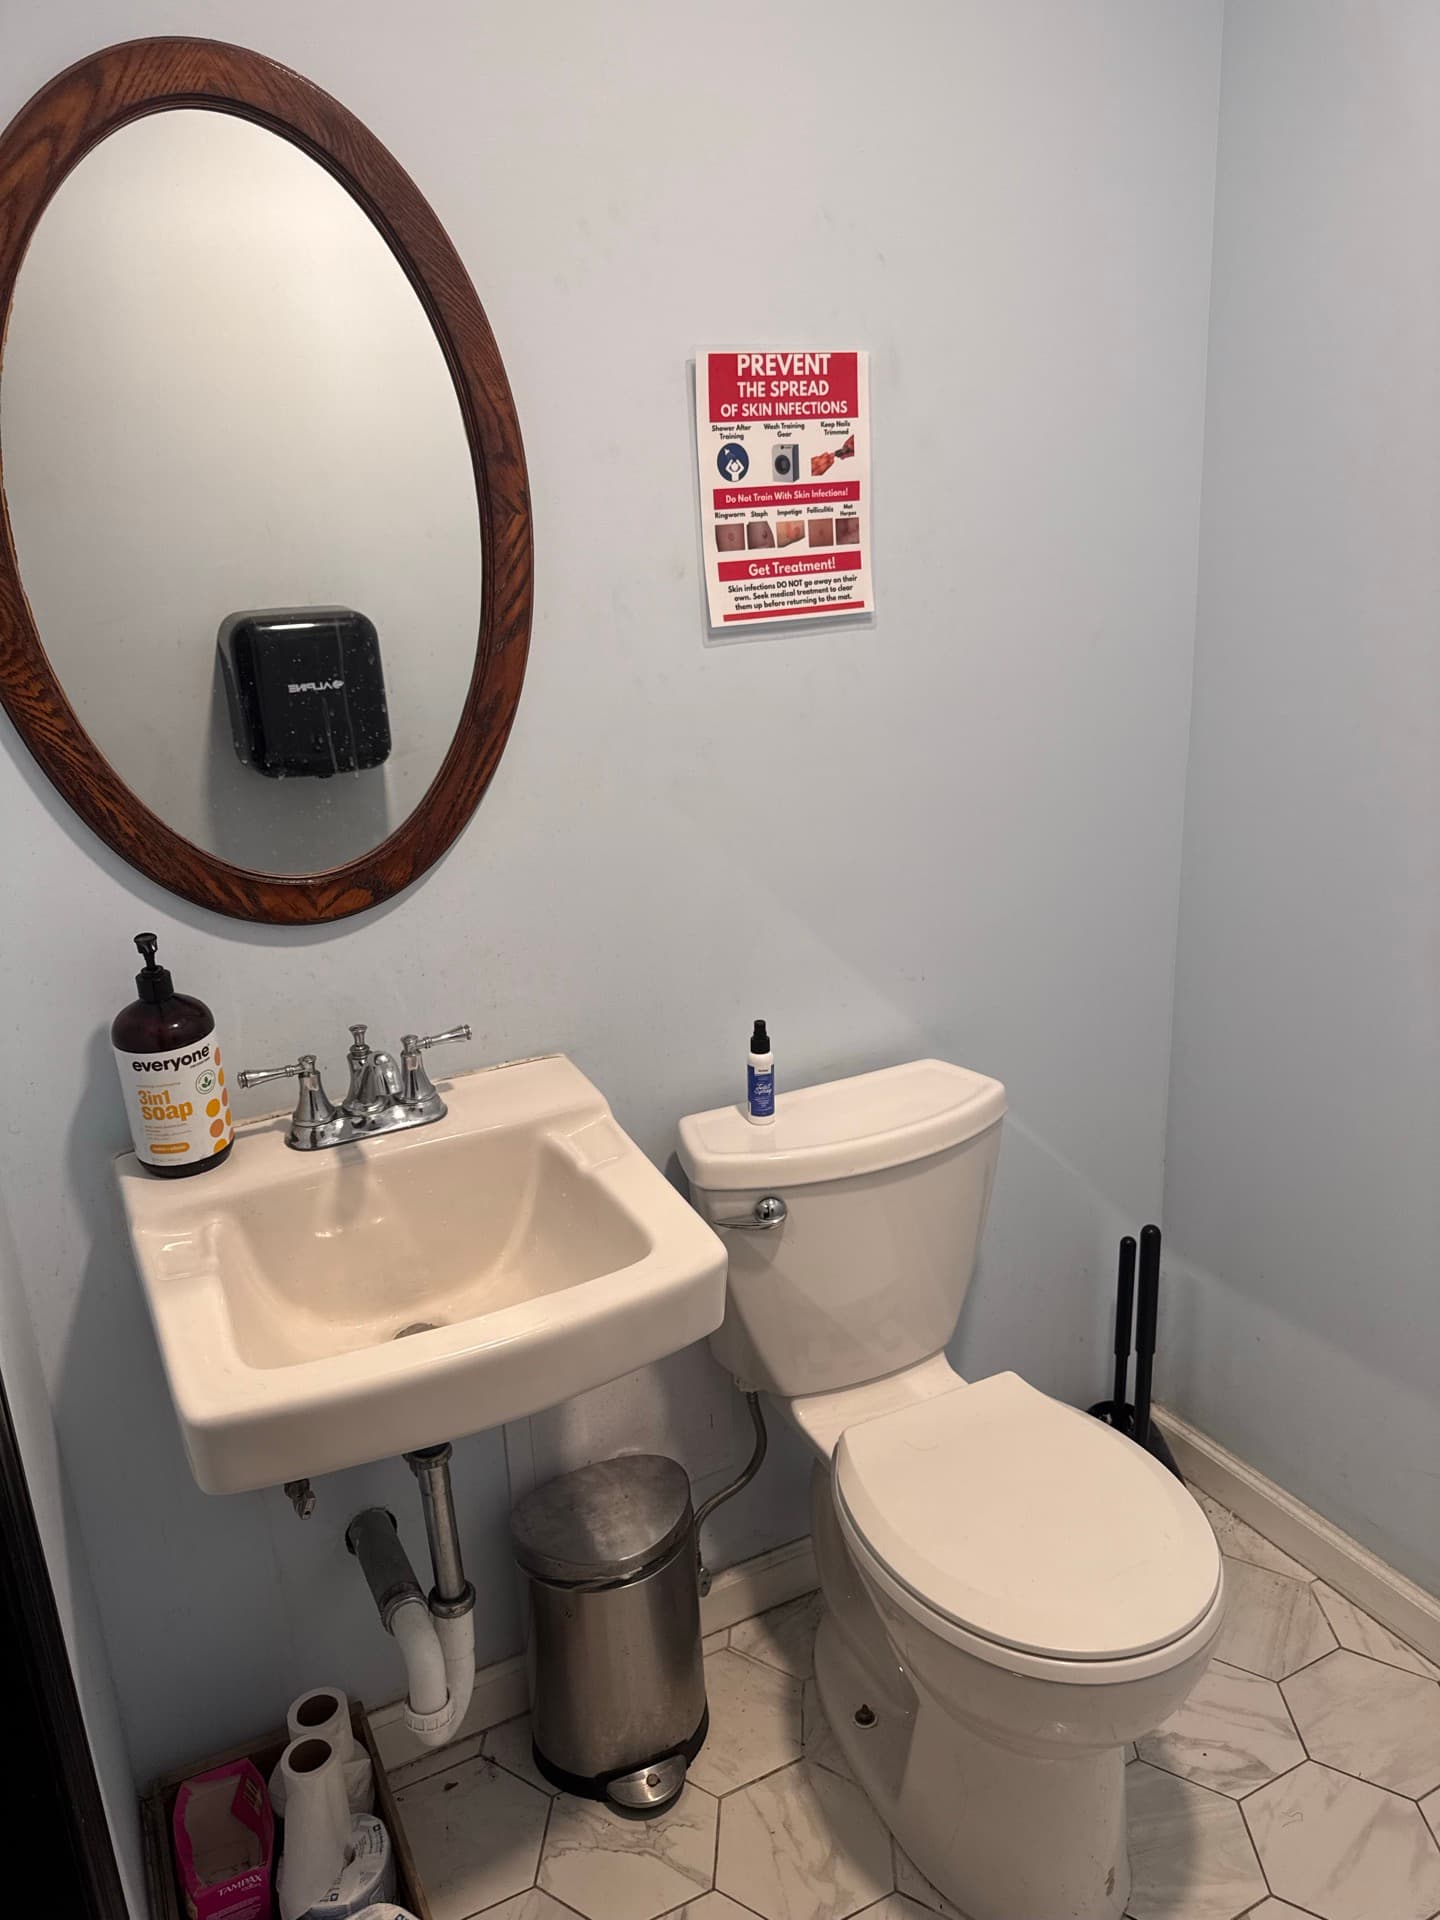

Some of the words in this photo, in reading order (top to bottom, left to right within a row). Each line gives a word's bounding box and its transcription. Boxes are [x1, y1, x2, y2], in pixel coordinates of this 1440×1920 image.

[737, 353, 831, 376] PREVENT
[737, 381, 766, 398] THE
[770, 380, 829, 397] SPREAD
[720, 404, 738, 417] OF
[742, 402, 772, 417] SKIN
[775, 400, 848, 416] INFECTIONS
[712, 424, 735, 432] Shower
[781, 422, 805, 430] Training
[820, 421, 835, 429] Keep
[824, 428, 849, 436] Trimmed
[720, 433, 744, 441] Training
[725, 495, 736, 503] Do
[738, 493, 753, 502] Not
[754, 492, 773, 501] Train
[774, 491, 793, 500] With
[794, 490, 810, 499] Skin
[811, 488, 849, 498] Infections!
[714, 511, 746, 520] Ringworm
[751, 511, 768, 519] Staph
[777, 509, 802, 517] Impetigo
[807, 506, 834, 514] Folliculitis
[748, 563, 770, 577] Get
[772, 556, 836, 575] Treatment!
[728, 585, 743, 593] Skin
[744, 583, 775, 591] infections
[776, 581, 787, 589] DO
[788, 580, 803, 588] NOT
[804, 580, 812, 588] go
[814, 579, 832, 587] away
[752, 592, 769, 600] Seek
[770, 590, 796, 599] medical
[797, 587, 829, 596] treatment
[735, 603, 753, 611] them
[754, 602, 763, 610] up
[763, 599, 786, 609] before
[786, 597, 817, 607] returning
[818, 595, 825, 603] to
[132, 1046, 210, 1072] everyone
[138, 1090, 171, 1106] 3in1
[141, 1101, 193, 1122] soap
[217, 1874, 262, 1896] TAMPAX
